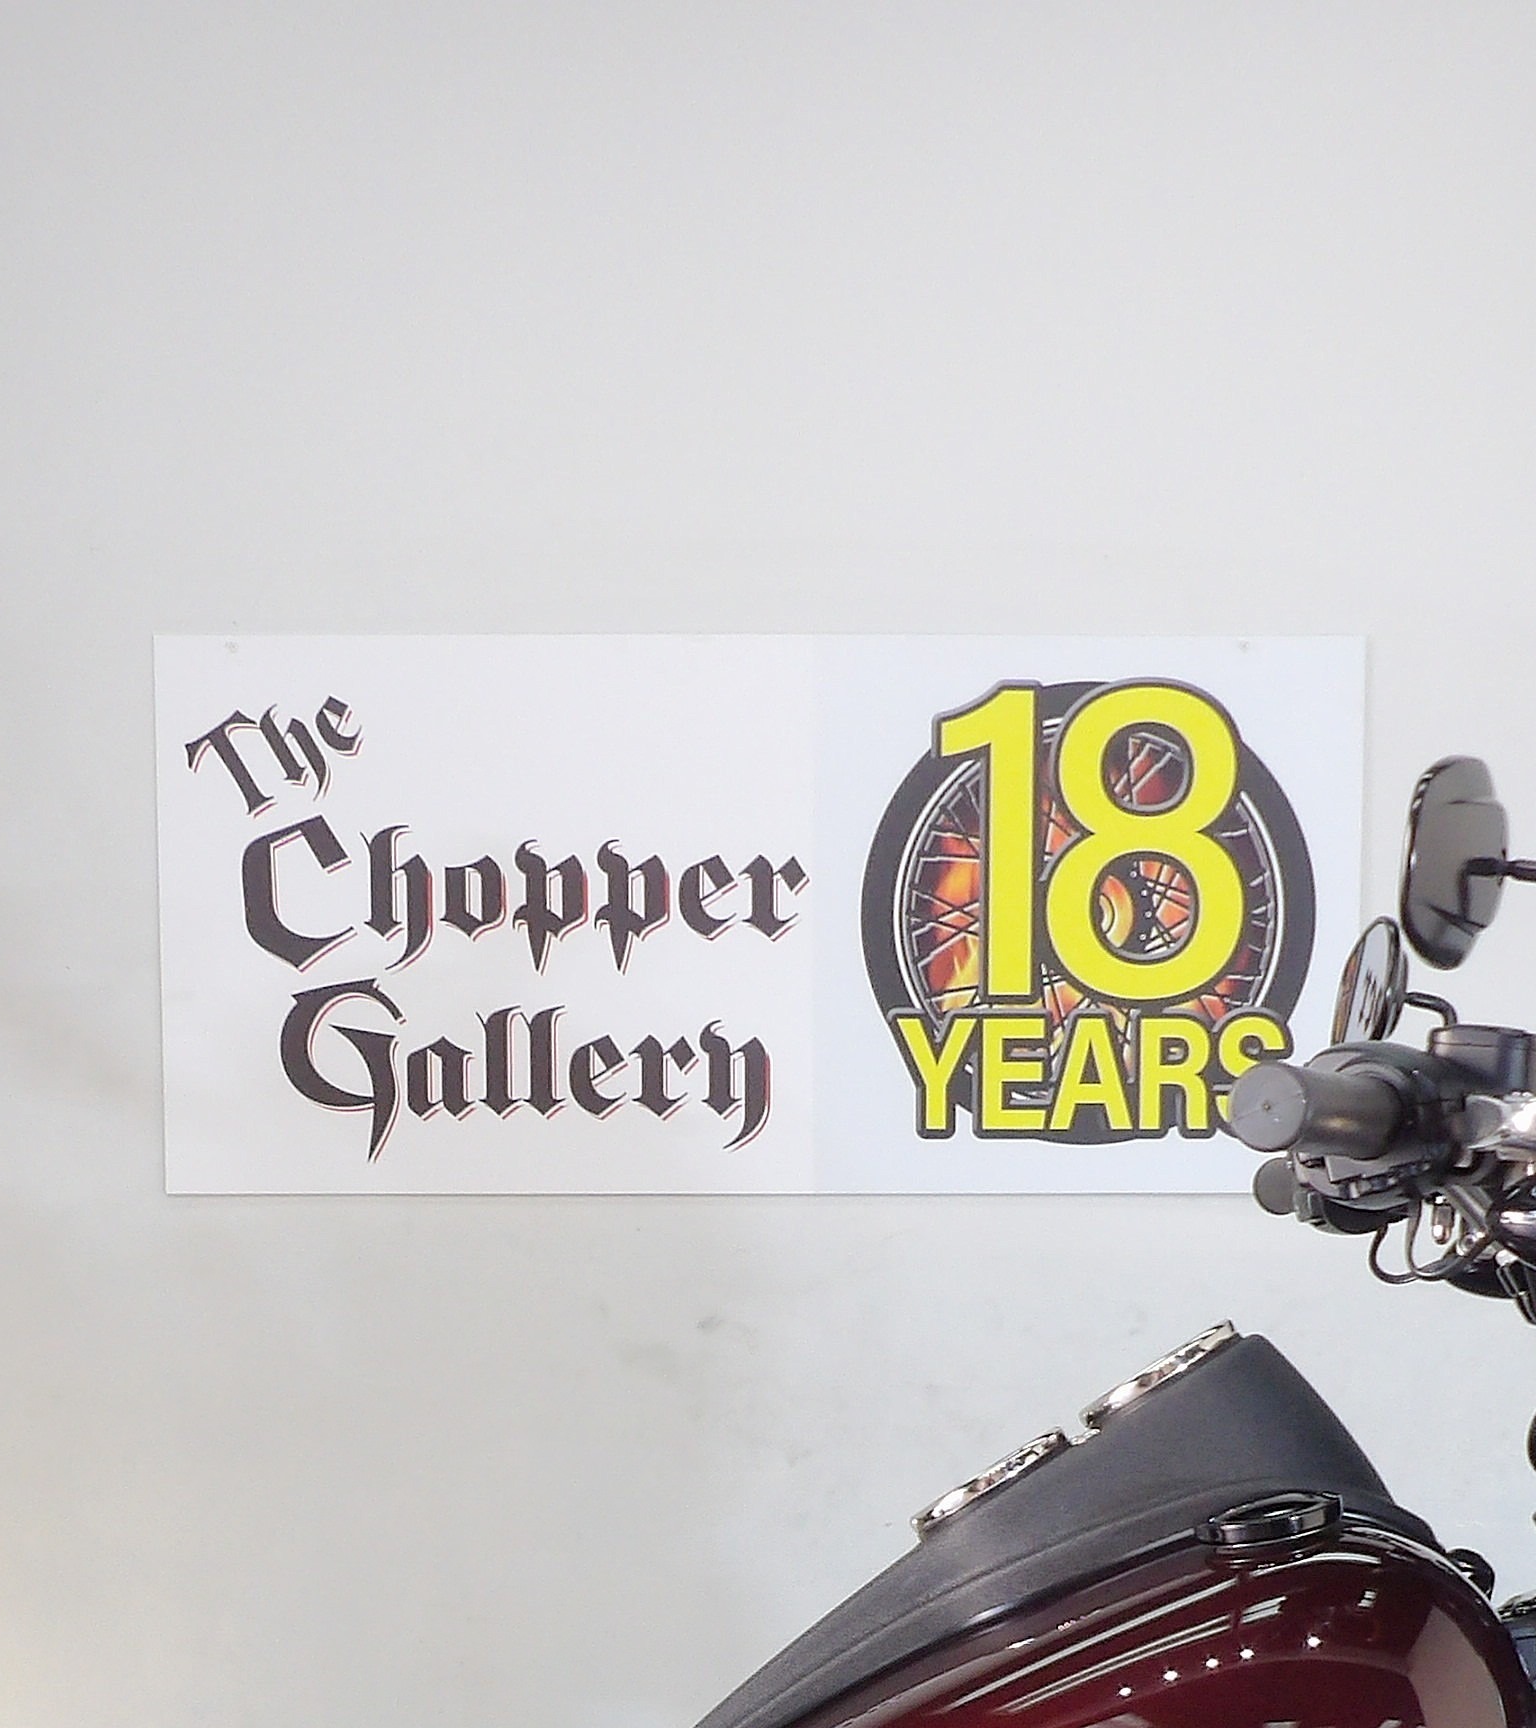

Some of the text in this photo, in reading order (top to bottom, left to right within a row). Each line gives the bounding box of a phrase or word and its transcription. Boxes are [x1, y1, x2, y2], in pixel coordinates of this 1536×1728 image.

[184, 694, 363, 818] The
[936, 681, 1250, 1004] 18
[241, 813, 809, 975] Chopper
[278, 976, 772, 1163] Gallery
